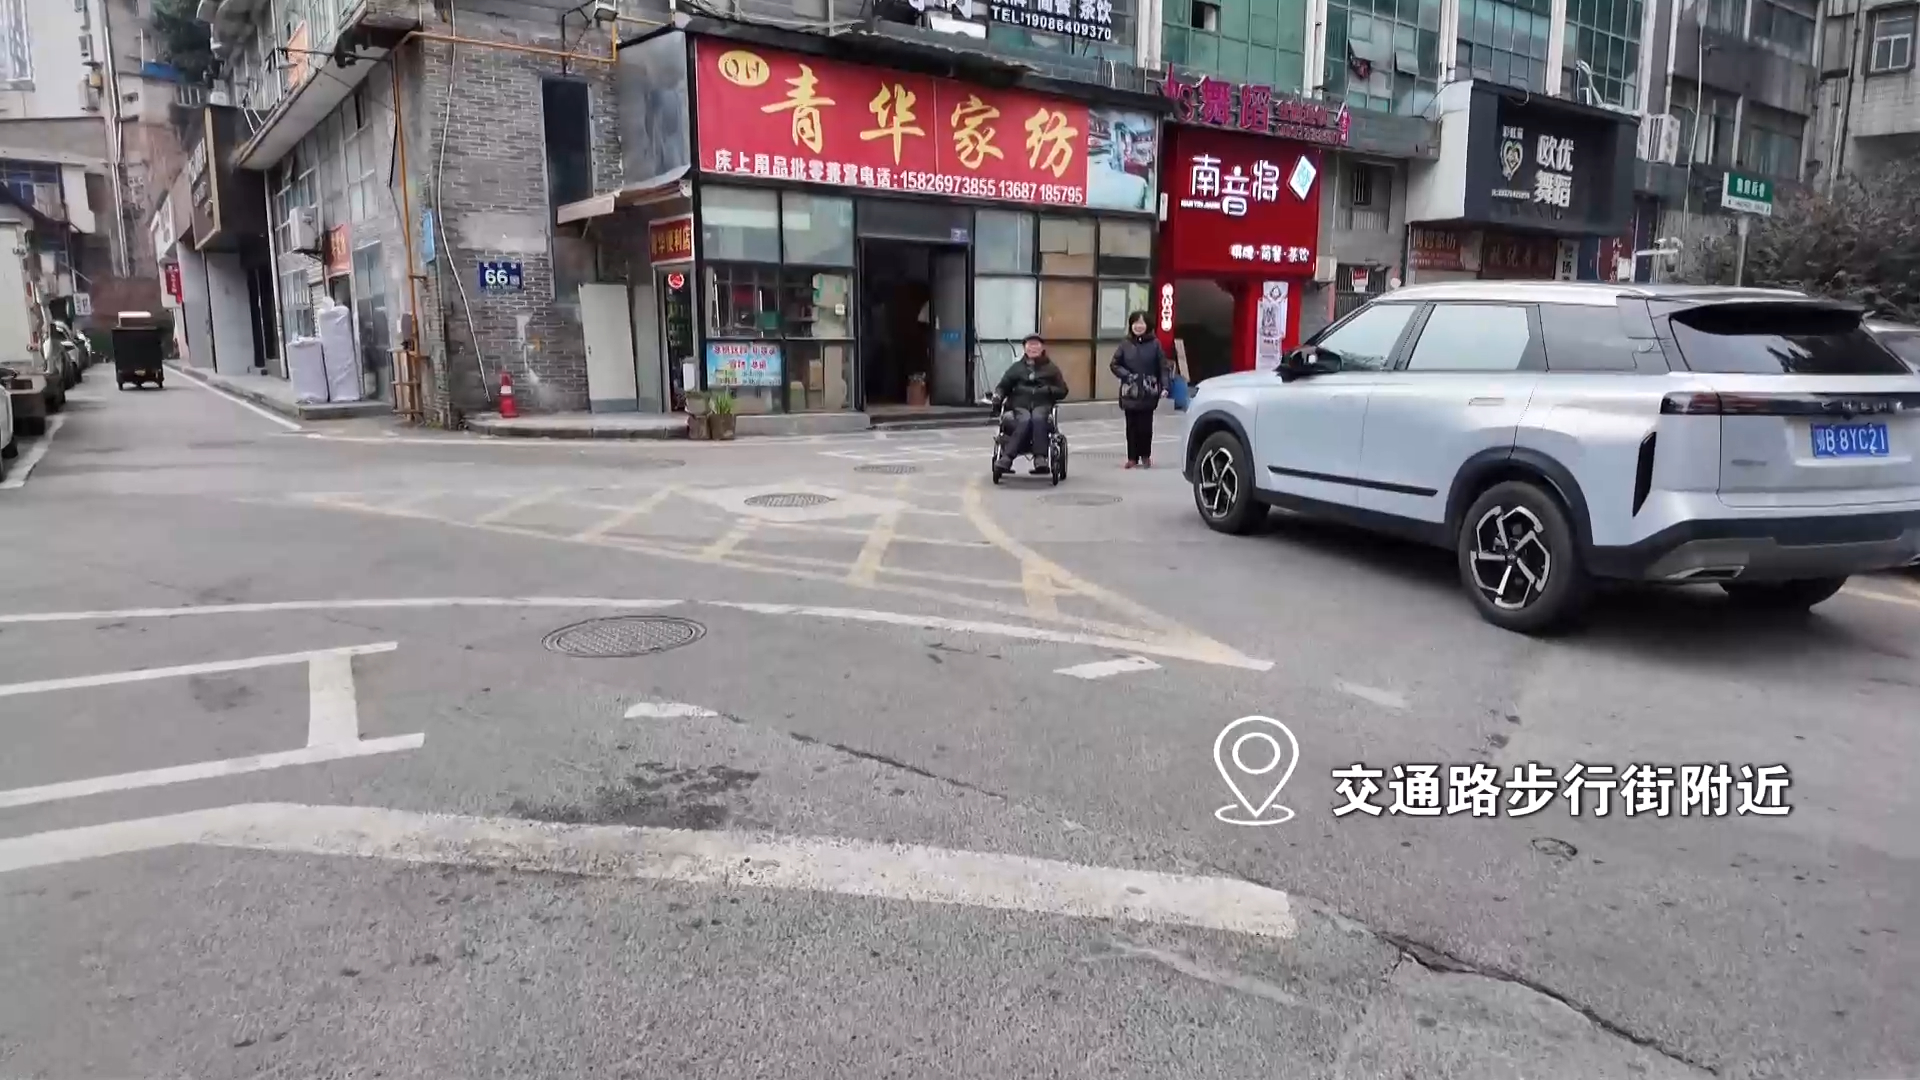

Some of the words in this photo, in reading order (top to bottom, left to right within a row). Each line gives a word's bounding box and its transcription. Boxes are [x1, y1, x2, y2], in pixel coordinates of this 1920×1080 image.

[724, 58, 760, 81] QH
[761, 64, 1079, 178] 青华家纺
[1536, 134, 1574, 172] 欧优
[1189, 154, 1280, 216] 南音将
[1533, 169, 1572, 207] 舞蹈
[485, 268, 508, 285] 66
